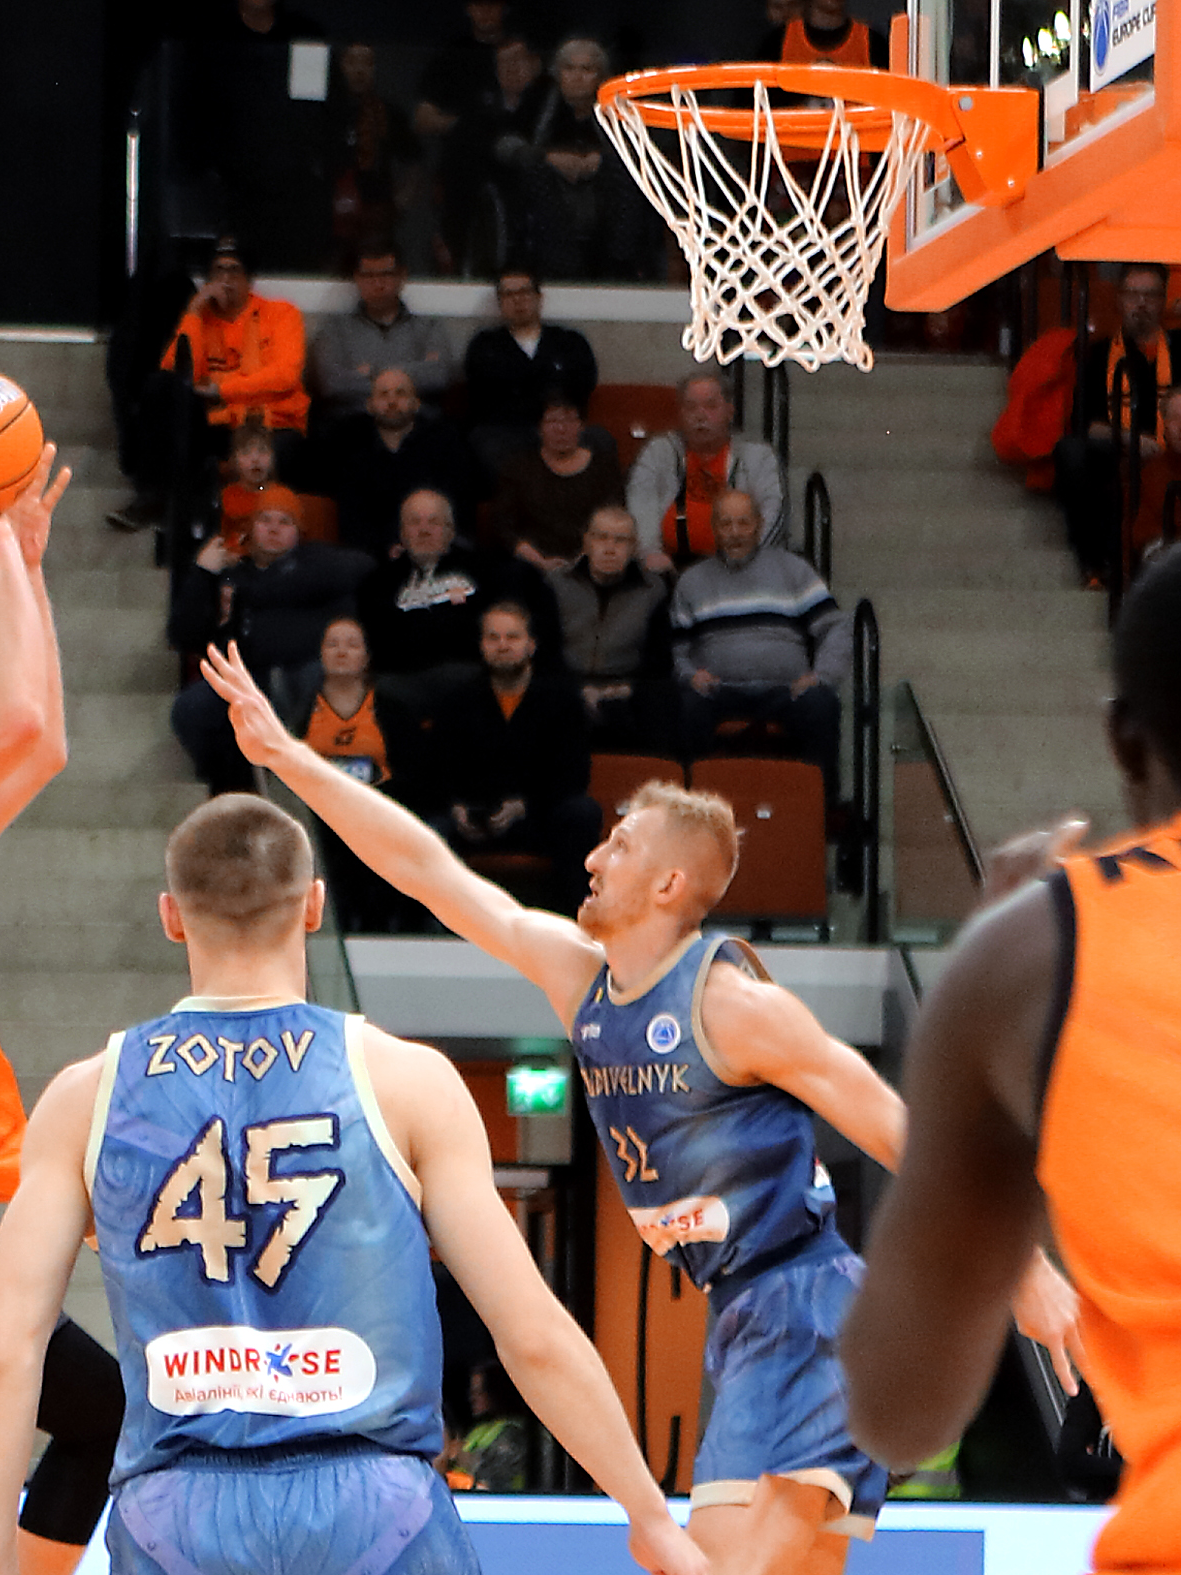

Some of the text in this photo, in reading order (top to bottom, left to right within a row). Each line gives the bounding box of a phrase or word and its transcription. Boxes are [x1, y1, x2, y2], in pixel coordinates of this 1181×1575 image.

[1113, 13, 1140, 47] EUROPE
[146, 1030, 315, 1083] ZOTOV
[580, 1063, 690, 1098] UDIVELNYK
[137, 1114, 345, 1292] 45
